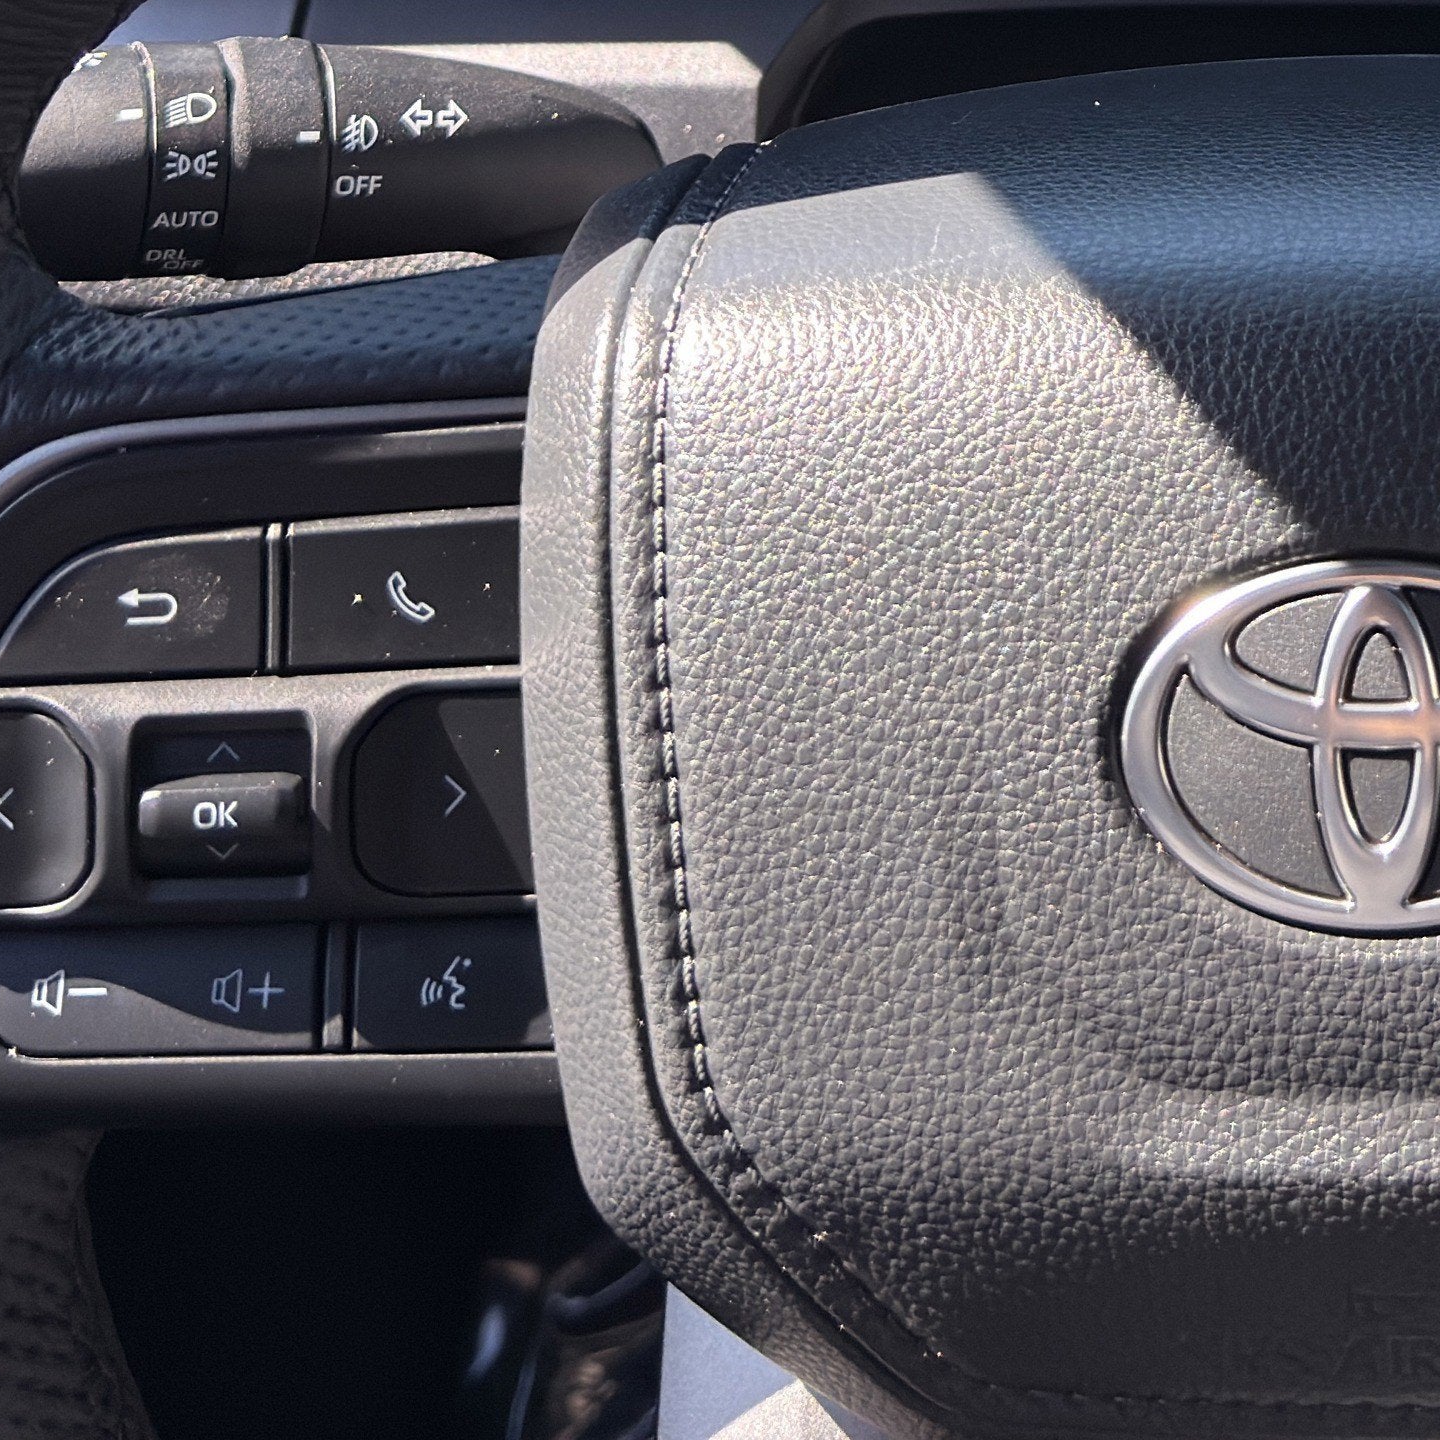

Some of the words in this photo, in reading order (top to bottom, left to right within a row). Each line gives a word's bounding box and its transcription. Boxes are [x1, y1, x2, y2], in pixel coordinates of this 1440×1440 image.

[334, 174, 382, 197] OFF
[151, 210, 219, 229] AUTO
[145, 248, 187, 262] DRL
[193, 801, 239, 829] OK
